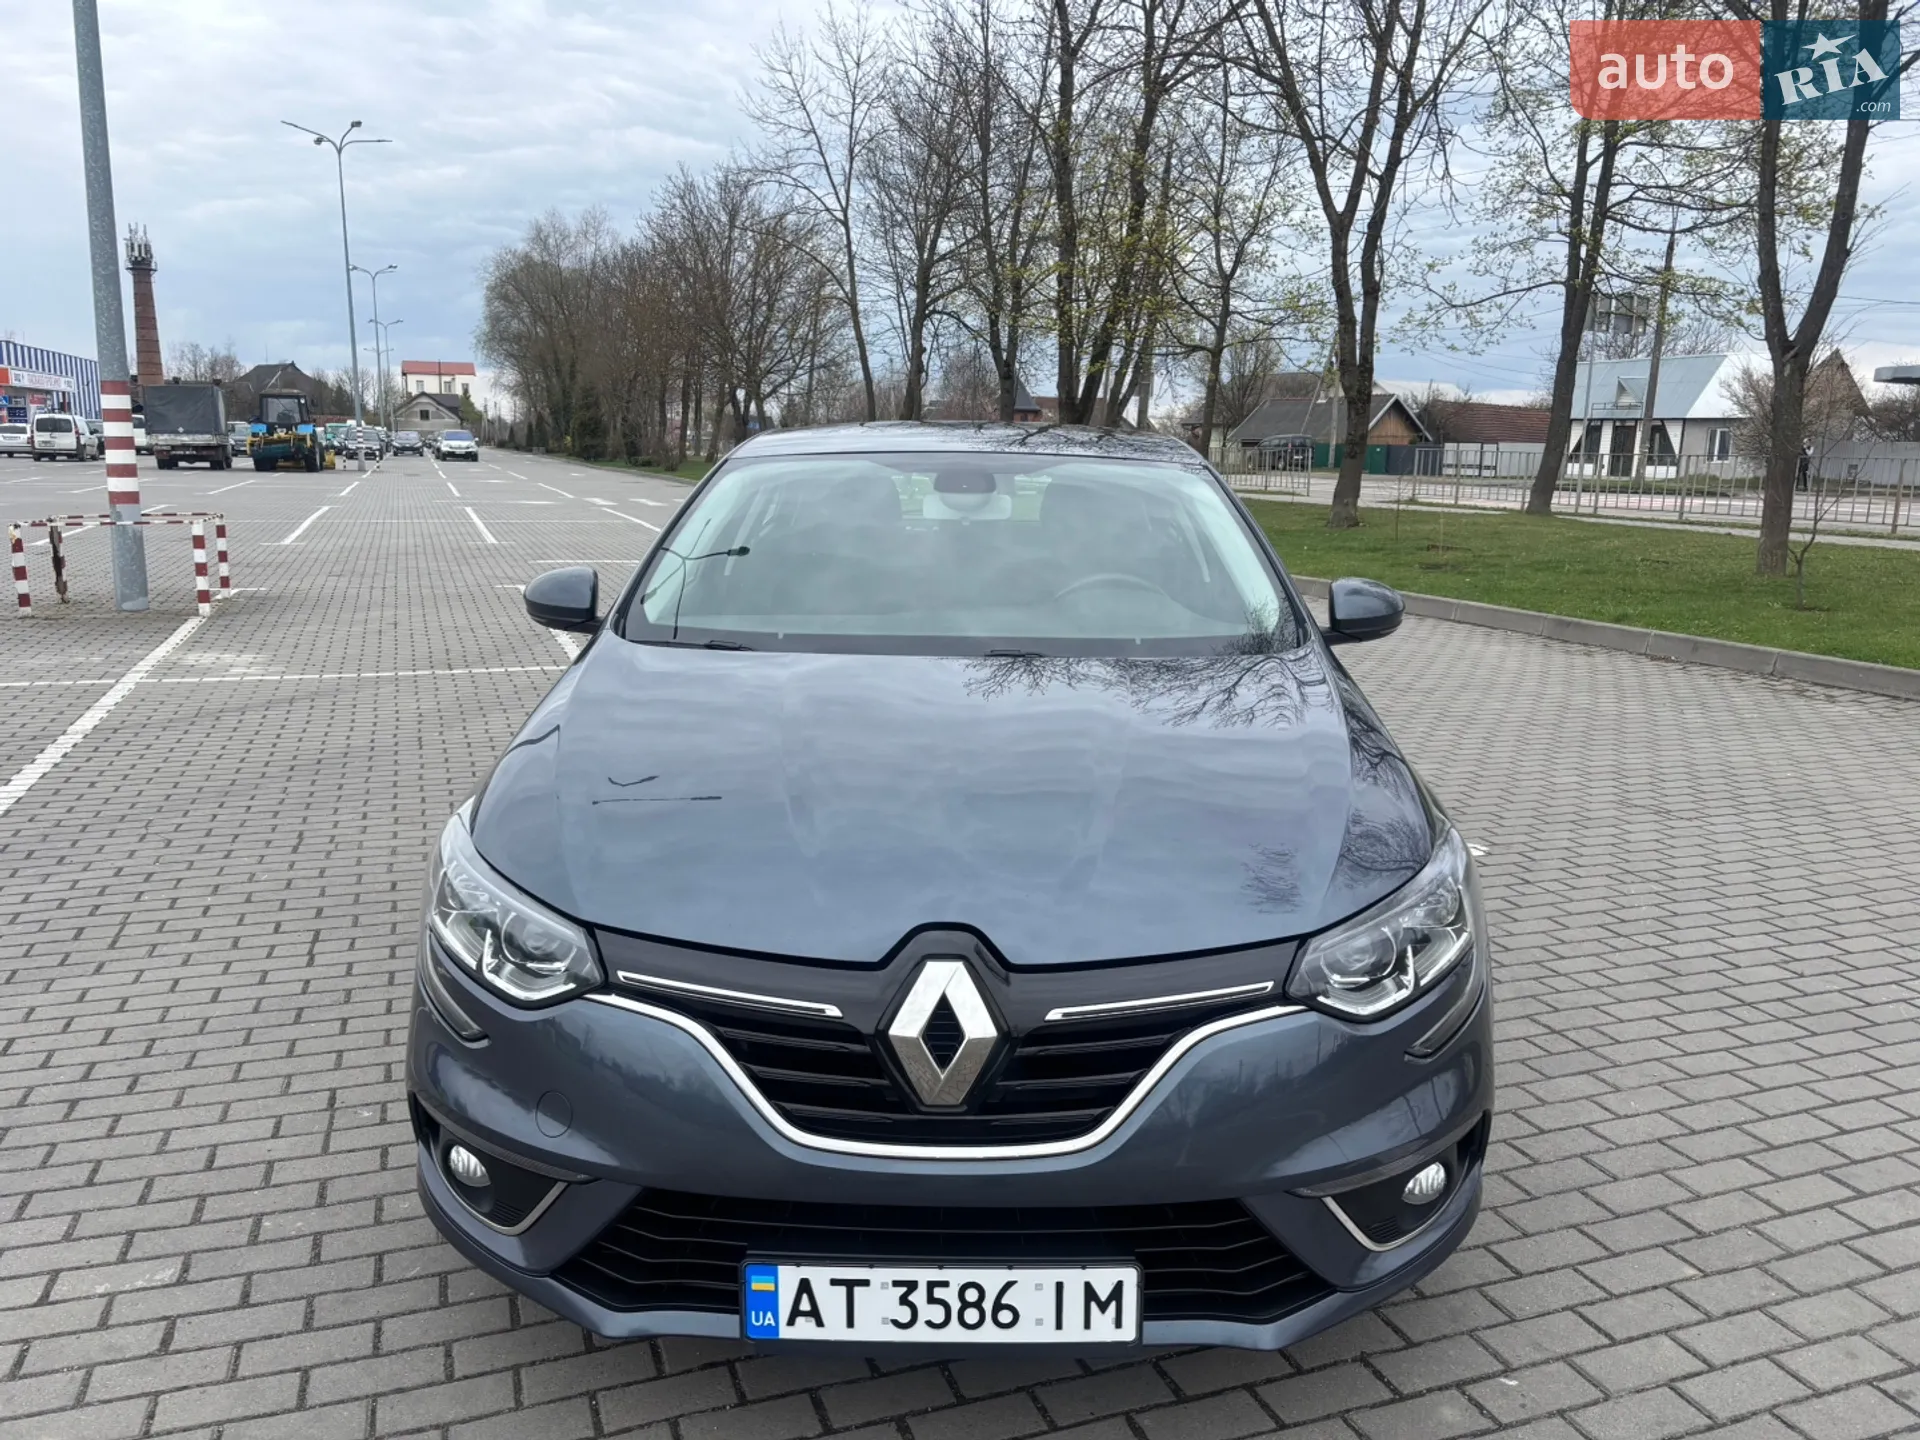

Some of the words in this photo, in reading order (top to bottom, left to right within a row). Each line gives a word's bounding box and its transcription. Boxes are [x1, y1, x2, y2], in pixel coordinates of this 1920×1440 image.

[751, 1311, 775, 1326] UA
[786, 1277, 870, 1328] AT
[890, 1280, 1020, 1330] 3586
[1055, 1280, 1123, 1330] IM
